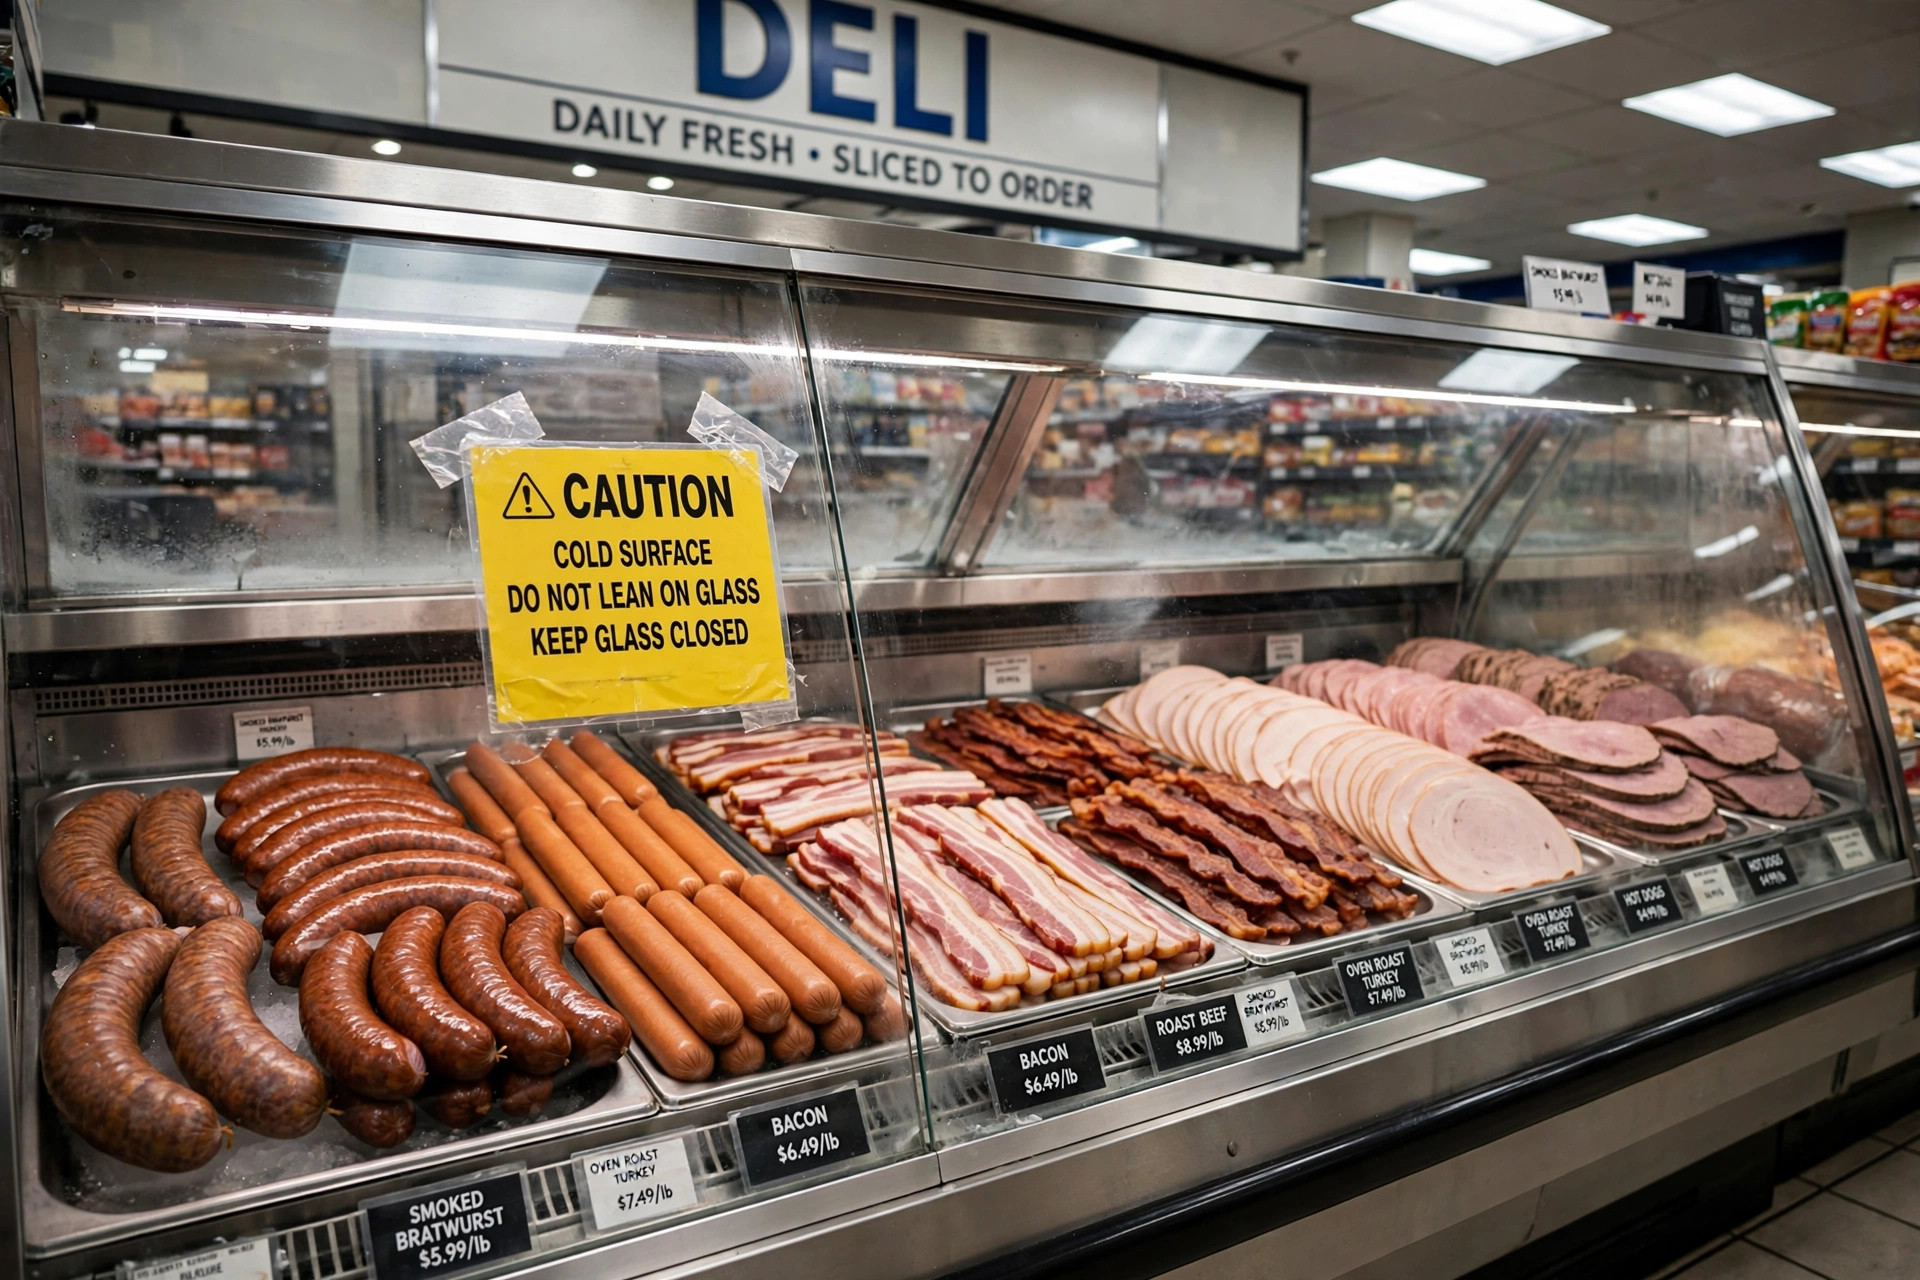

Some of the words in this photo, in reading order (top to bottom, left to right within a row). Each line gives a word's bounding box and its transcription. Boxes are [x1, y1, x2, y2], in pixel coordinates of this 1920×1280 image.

[696, 0, 988, 143] DELI
[554, 98, 667, 146] DAILY
[682, 120, 793, 164] FRESH
[833, 144, 942, 187] SLICED
[953, 163, 991, 194] TO
[1001, 171, 1093, 210] ORDER
[563, 472, 734, 518] CAUTION
[553, 541, 613, 569] COLD
[620, 539, 713, 566] SURFACE
[507, 584, 540, 613] DO
[546, 582, 591, 612] NOT
[598, 580, 654, 609] LEAN
[660, 579, 690, 607] ON
[696, 577, 760, 605] GLASS
[530, 626, 588, 656] KEEP
[595, 622, 665, 652] GLASS
[669, 618, 749, 649] CLOSED
[1623, 890, 1642, 907] HOT
[1640, 885, 1665, 902] DOGS
[1525, 912, 1548, 928] OVEN
[1547, 905, 1573, 922] ROAST
[1537, 920, 1570, 938] TURKEY
[1346, 962, 1373, 977] OVEN
[1375, 951, 1405, 971] ROAST
[1362, 969, 1400, 990] TURKEY
[1367, 987, 1406, 1005] $7.49/lb
[1156, 1013, 1195, 1036] ROAST
[1199, 1005, 1227, 1026] BEEF
[1019, 1042, 1069, 1070] BACON
[1176, 1031, 1224, 1056] $8.99/lb
[1024, 1067, 1078, 1095] $6.49/lb
[771, 1105, 828, 1136] BACON
[590, 1156, 620, 1174] OVEN
[624, 1149, 658, 1166] ROAST
[777, 1132, 840, 1164] $6.49/lb
[614, 1164, 655, 1184] TURKEY
[409, 1190, 484, 1224] SMOKED
[618, 1184, 673, 1211] $7.49/lb
[395, 1206, 504, 1251] BRATWURST
[418, 1235, 491, 1269] $5.99/lb
